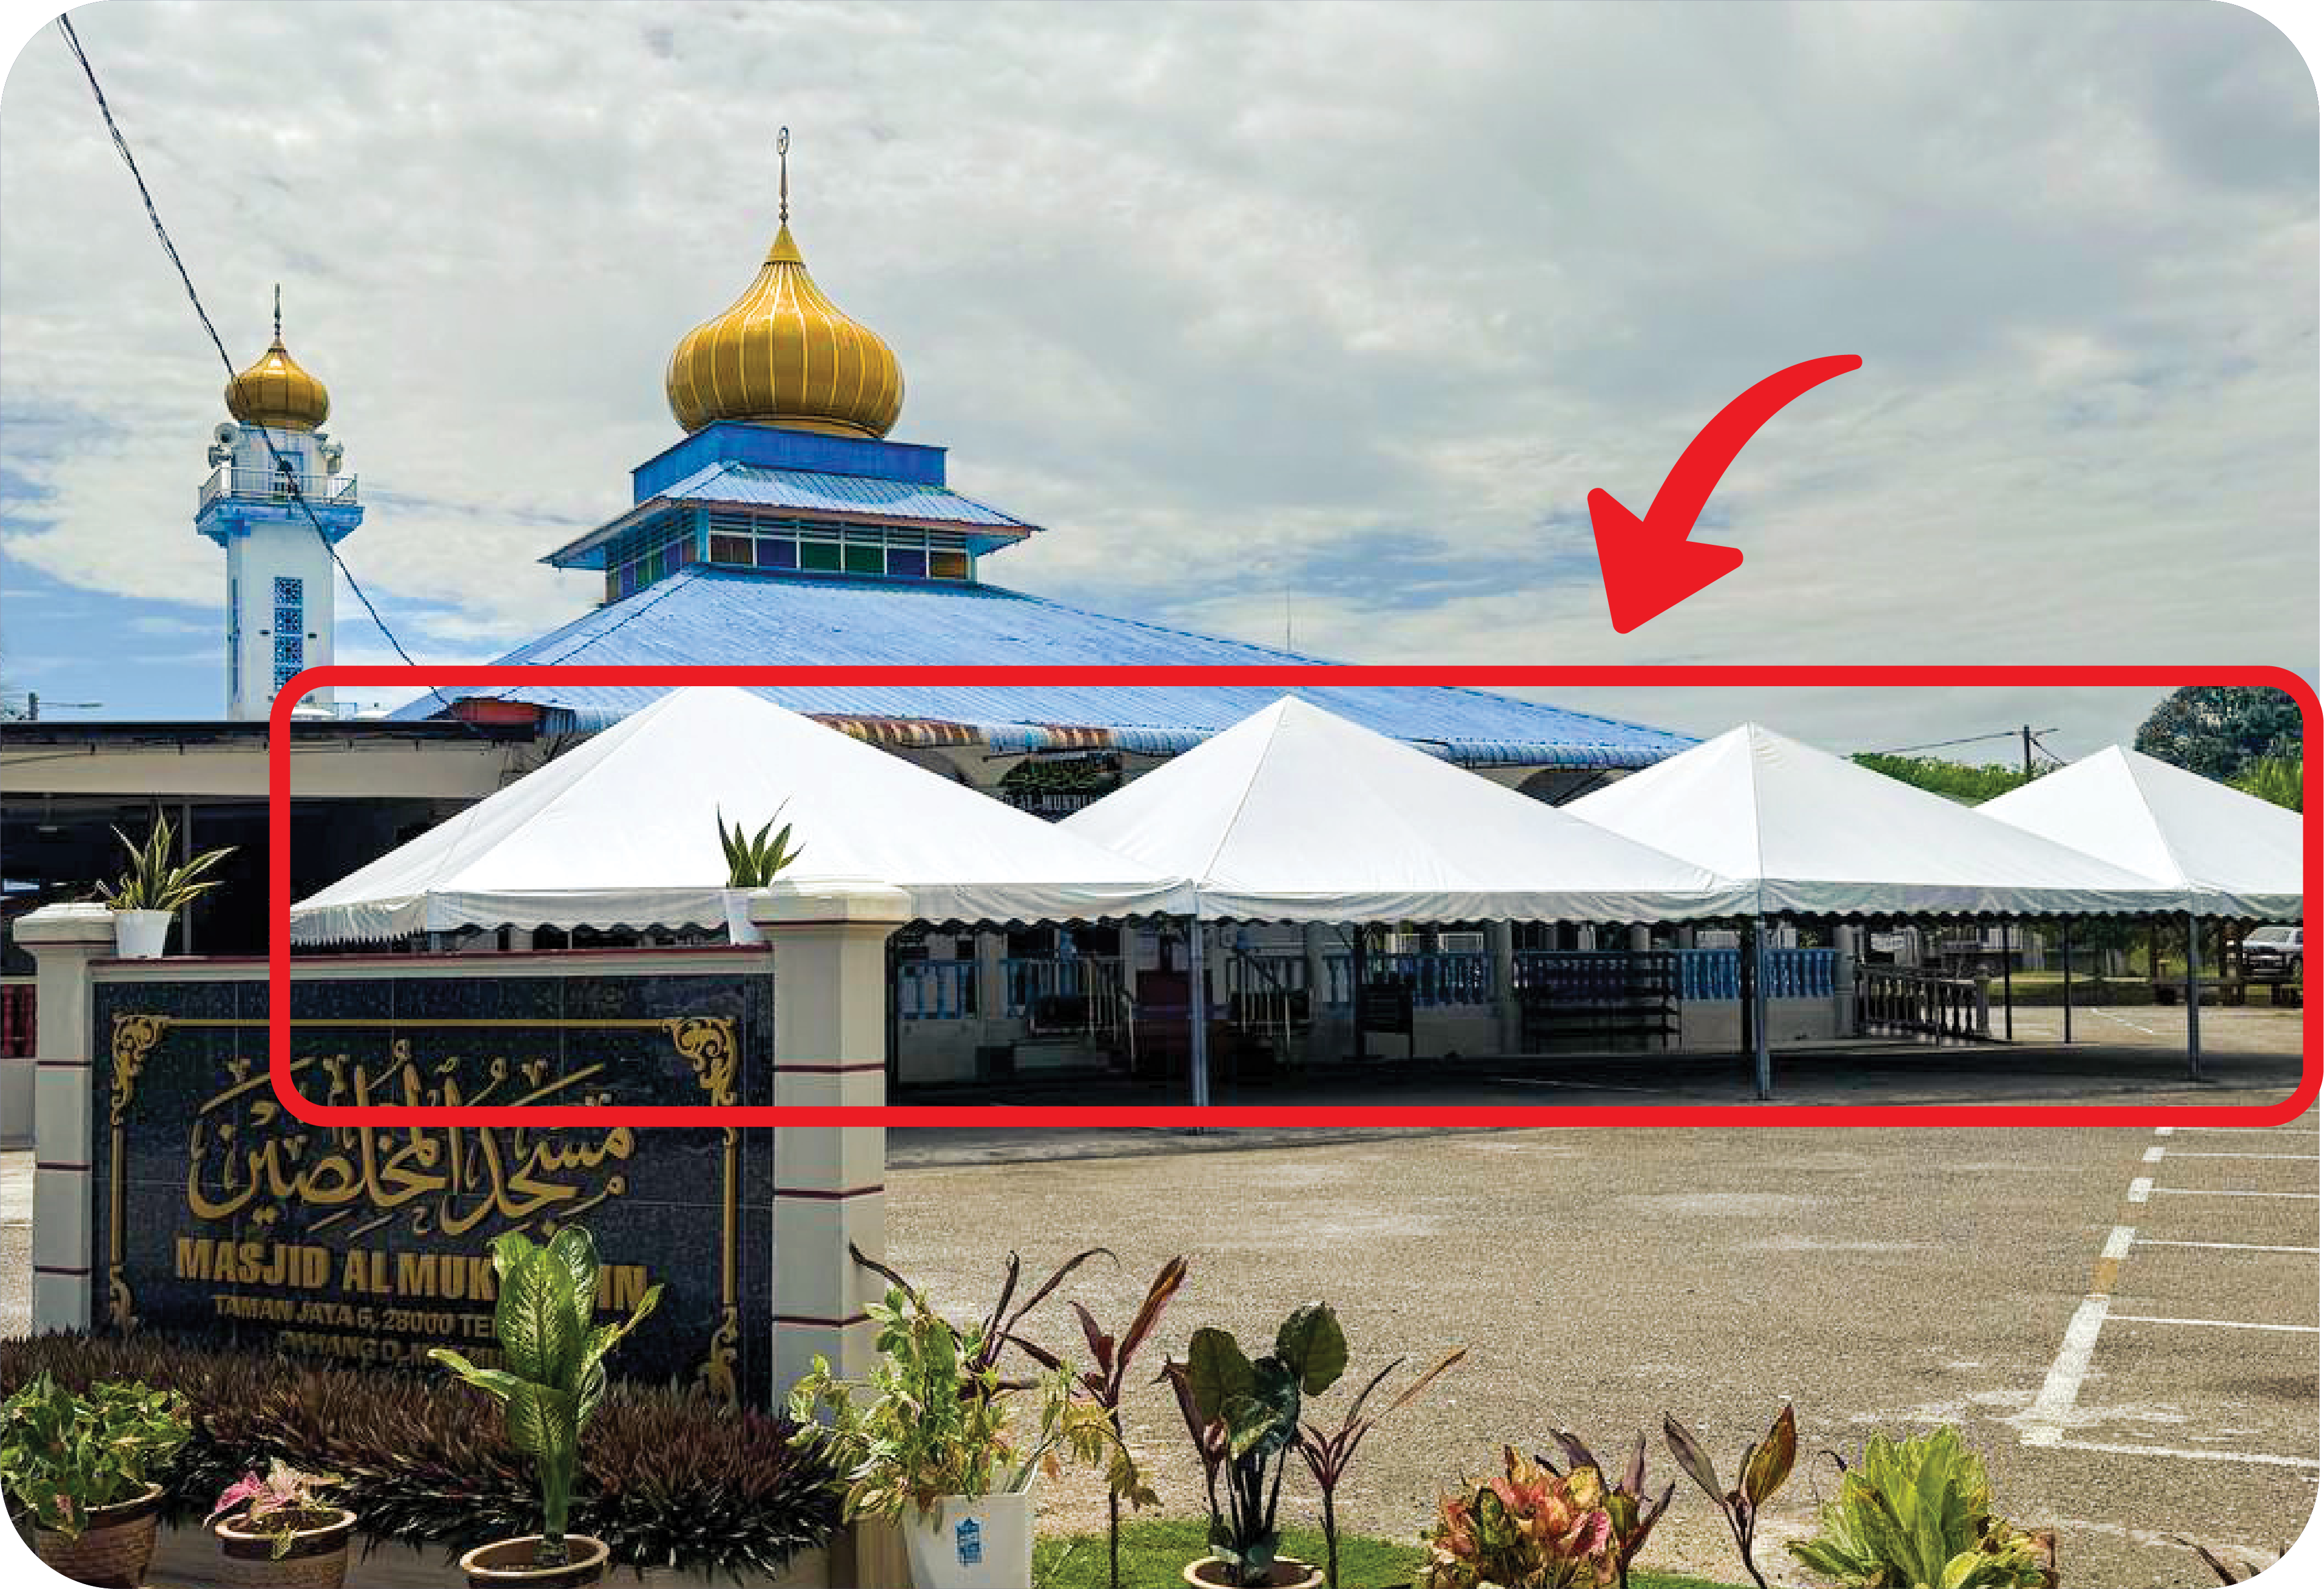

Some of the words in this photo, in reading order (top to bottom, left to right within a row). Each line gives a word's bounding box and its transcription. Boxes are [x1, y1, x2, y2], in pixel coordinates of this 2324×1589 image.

[176, 1236, 331, 1289] MASJID
[212, 1294, 292, 1321] TAMAN
[297, 1301, 355, 1328] JAYA
[382, 1309, 454, 1334] 28000
